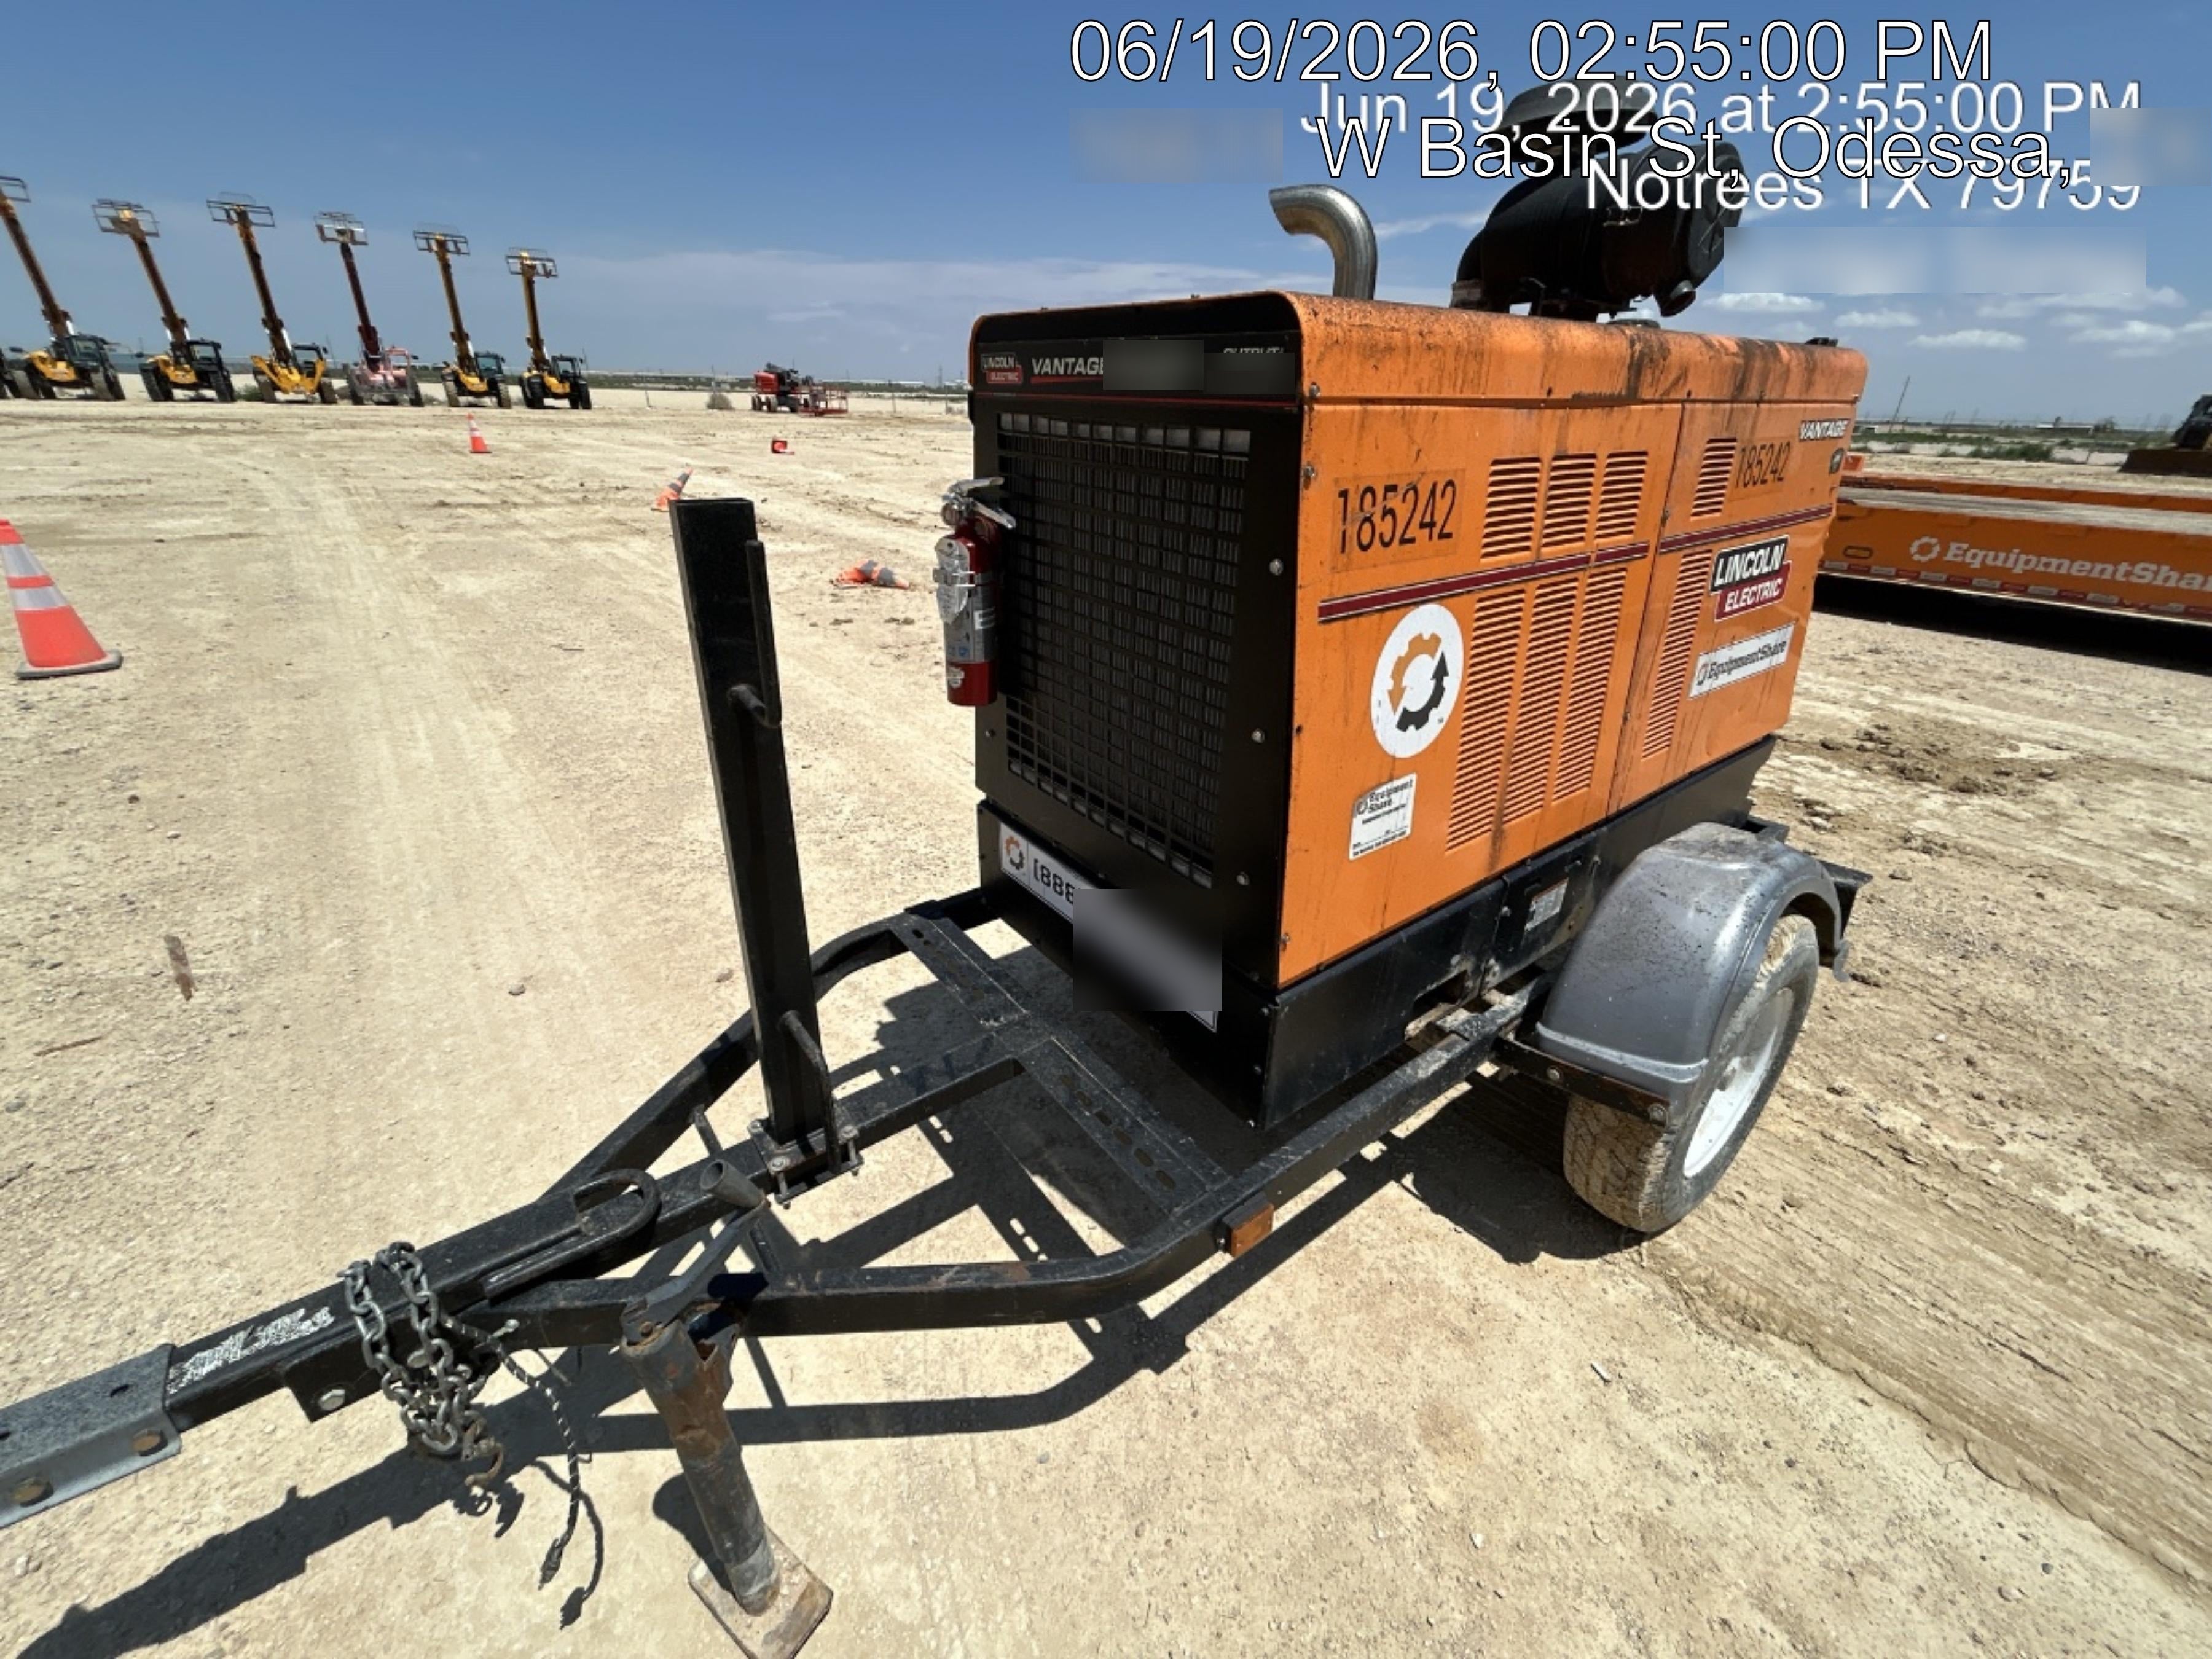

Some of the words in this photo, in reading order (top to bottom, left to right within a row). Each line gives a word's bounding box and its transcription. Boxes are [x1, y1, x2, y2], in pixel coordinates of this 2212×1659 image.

[1800, 419, 1849, 440] VANTAGE
[1735, 441, 1791, 489] 185242
[1338, 479, 1457, 554] 185242
[1714, 541, 1787, 587] LINCOLN
[1724, 577, 1783, 613] ELECTRIC
[1033, 858, 1073, 905] (888
